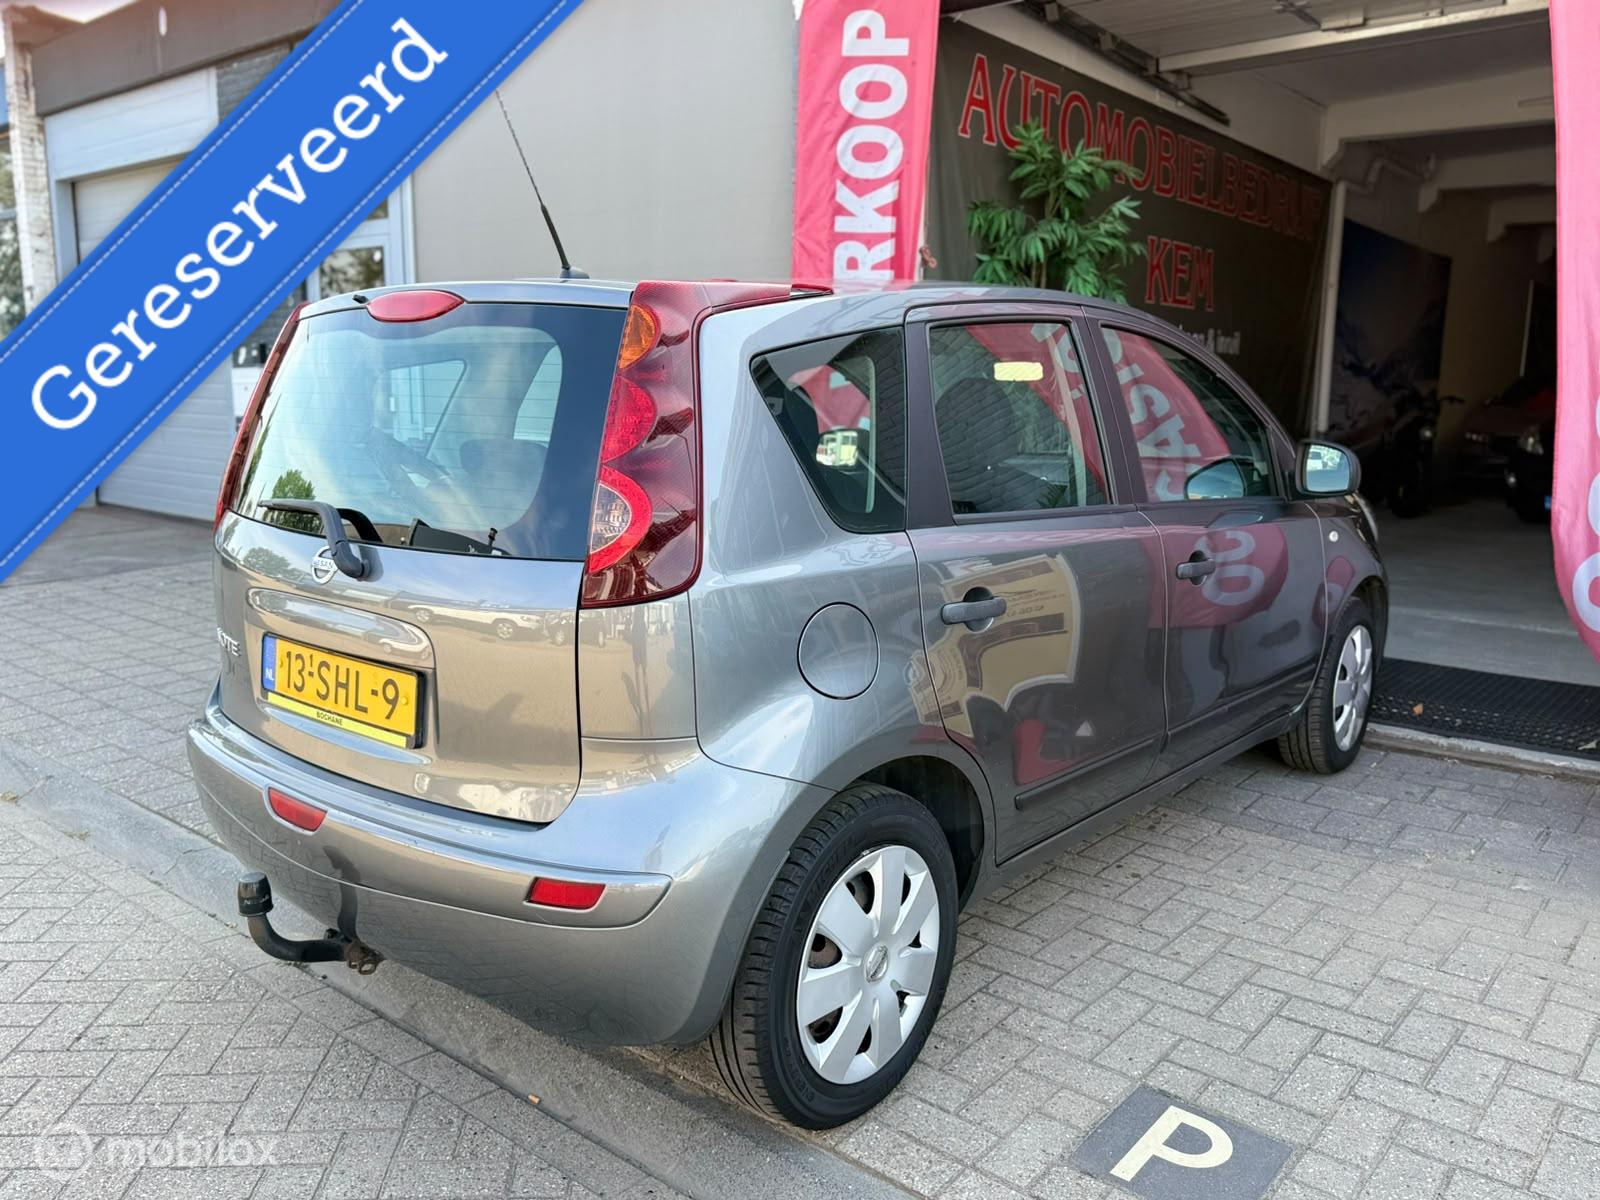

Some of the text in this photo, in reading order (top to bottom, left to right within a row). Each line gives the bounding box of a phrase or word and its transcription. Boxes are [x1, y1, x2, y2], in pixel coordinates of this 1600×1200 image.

[1145, 235, 1214, 311] KEM
[286, 650, 400, 720] 13-SHL-9
[1109, 1105, 1234, 1182] P
